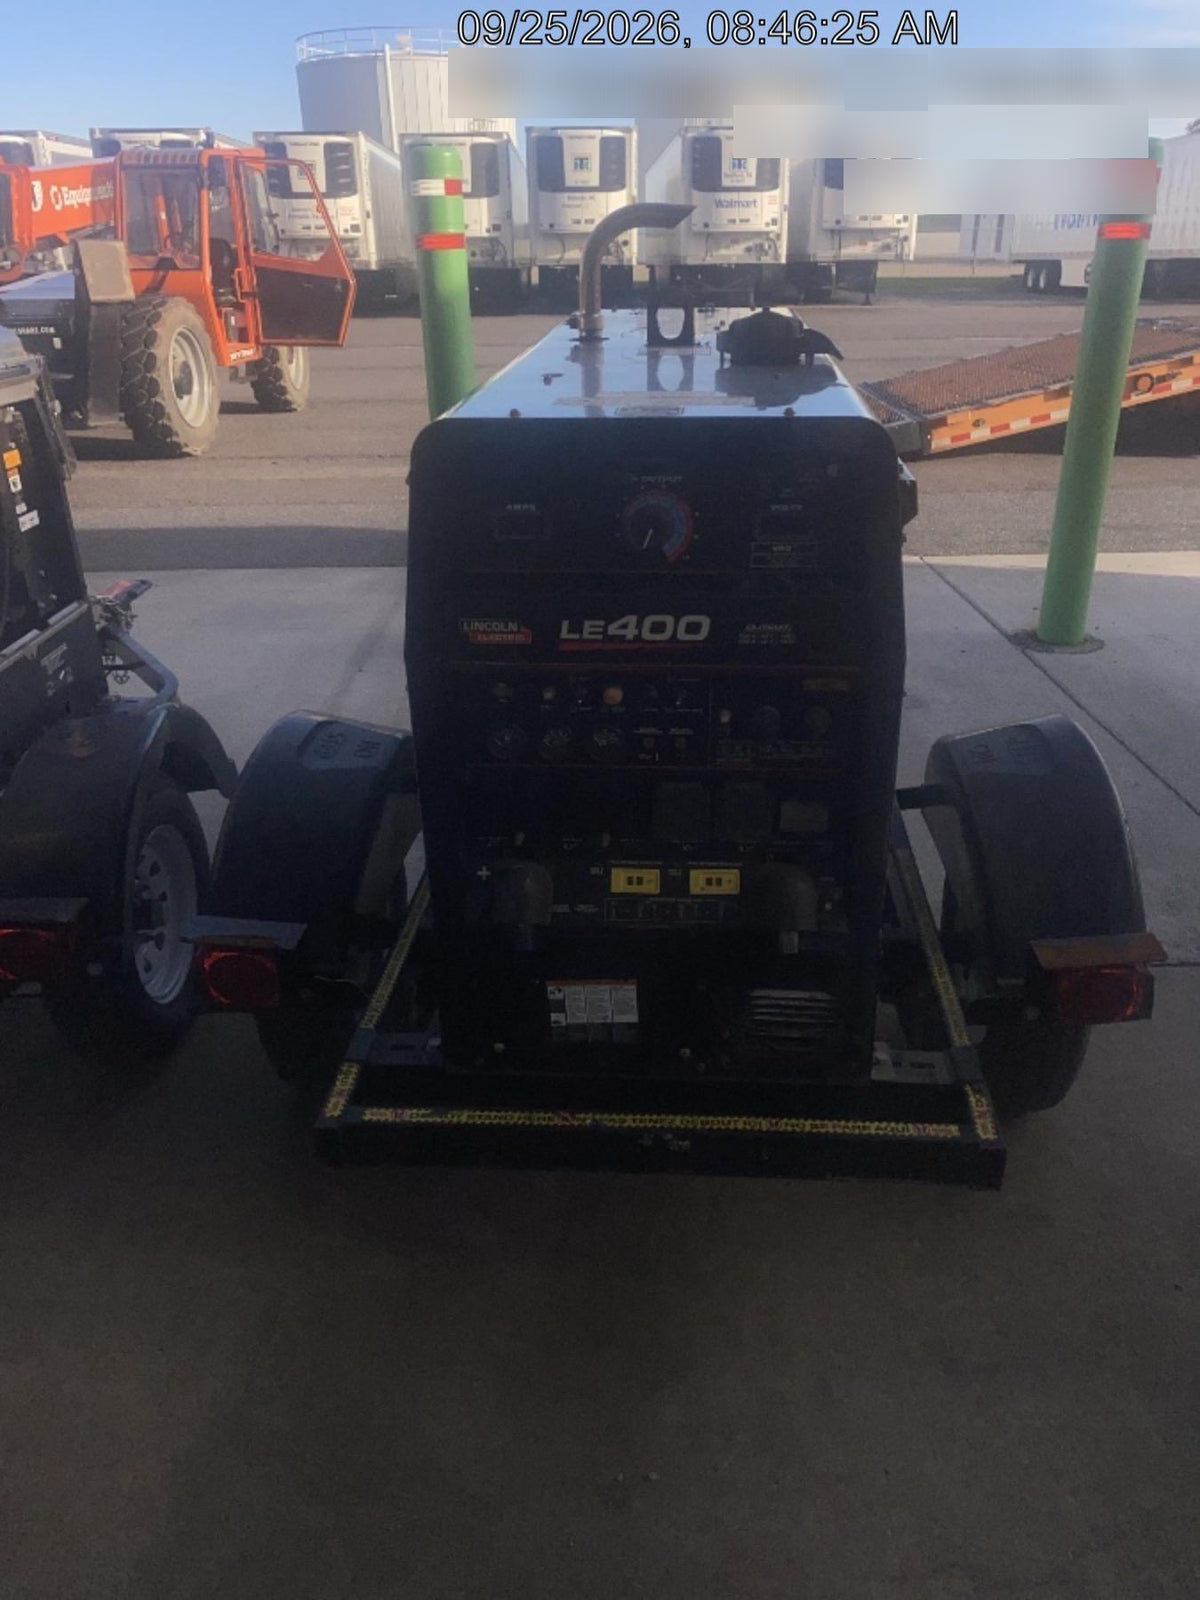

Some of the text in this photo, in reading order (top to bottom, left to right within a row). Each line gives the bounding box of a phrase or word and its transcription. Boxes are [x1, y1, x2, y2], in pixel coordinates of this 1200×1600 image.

[714, 199, 758, 209] Walmart
[461, 620, 518, 633] LINCOLN
[559, 614, 711, 641] LE400
